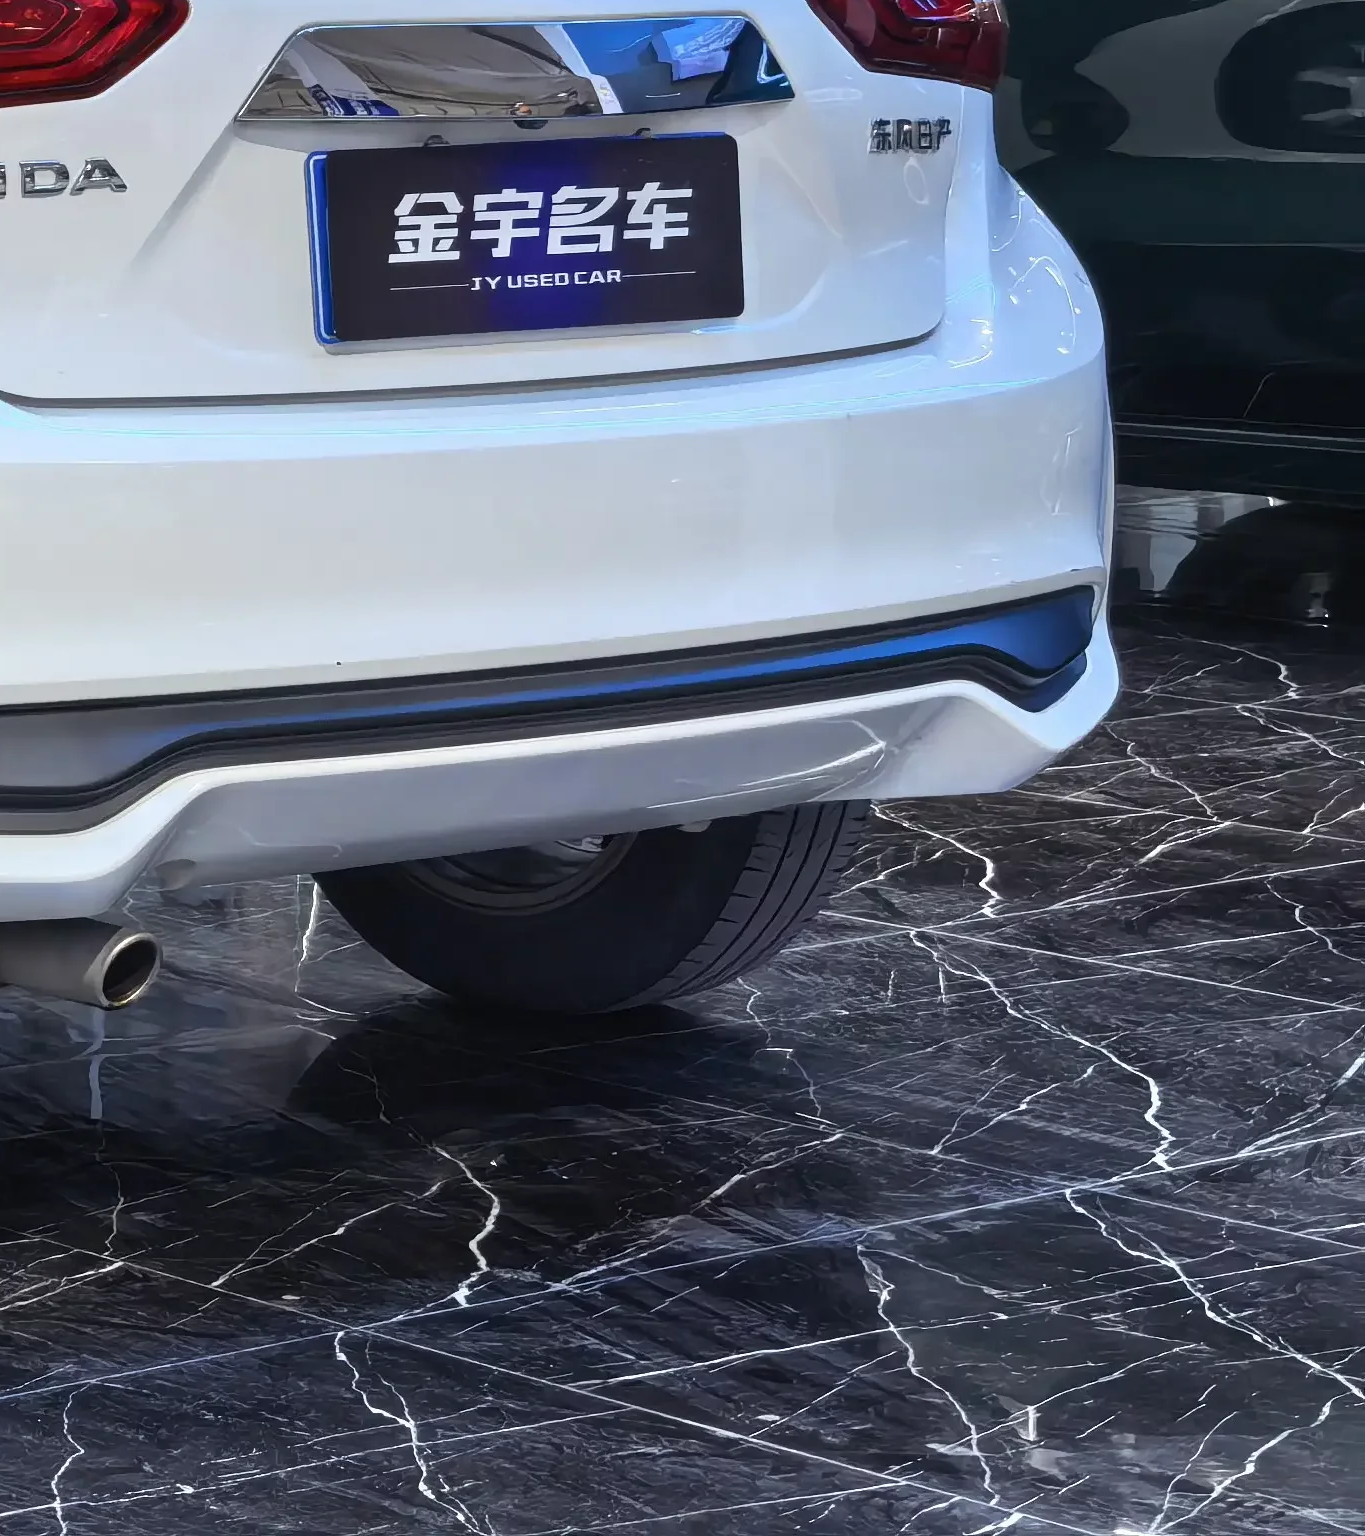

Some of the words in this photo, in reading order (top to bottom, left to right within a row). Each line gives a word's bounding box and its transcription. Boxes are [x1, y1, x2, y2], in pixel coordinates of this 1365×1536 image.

[387, 181, 693, 264] 金宇名车
[470, 275, 501, 291] JY
[507, 272, 569, 289] USED
[573, 269, 621, 285] CAR
